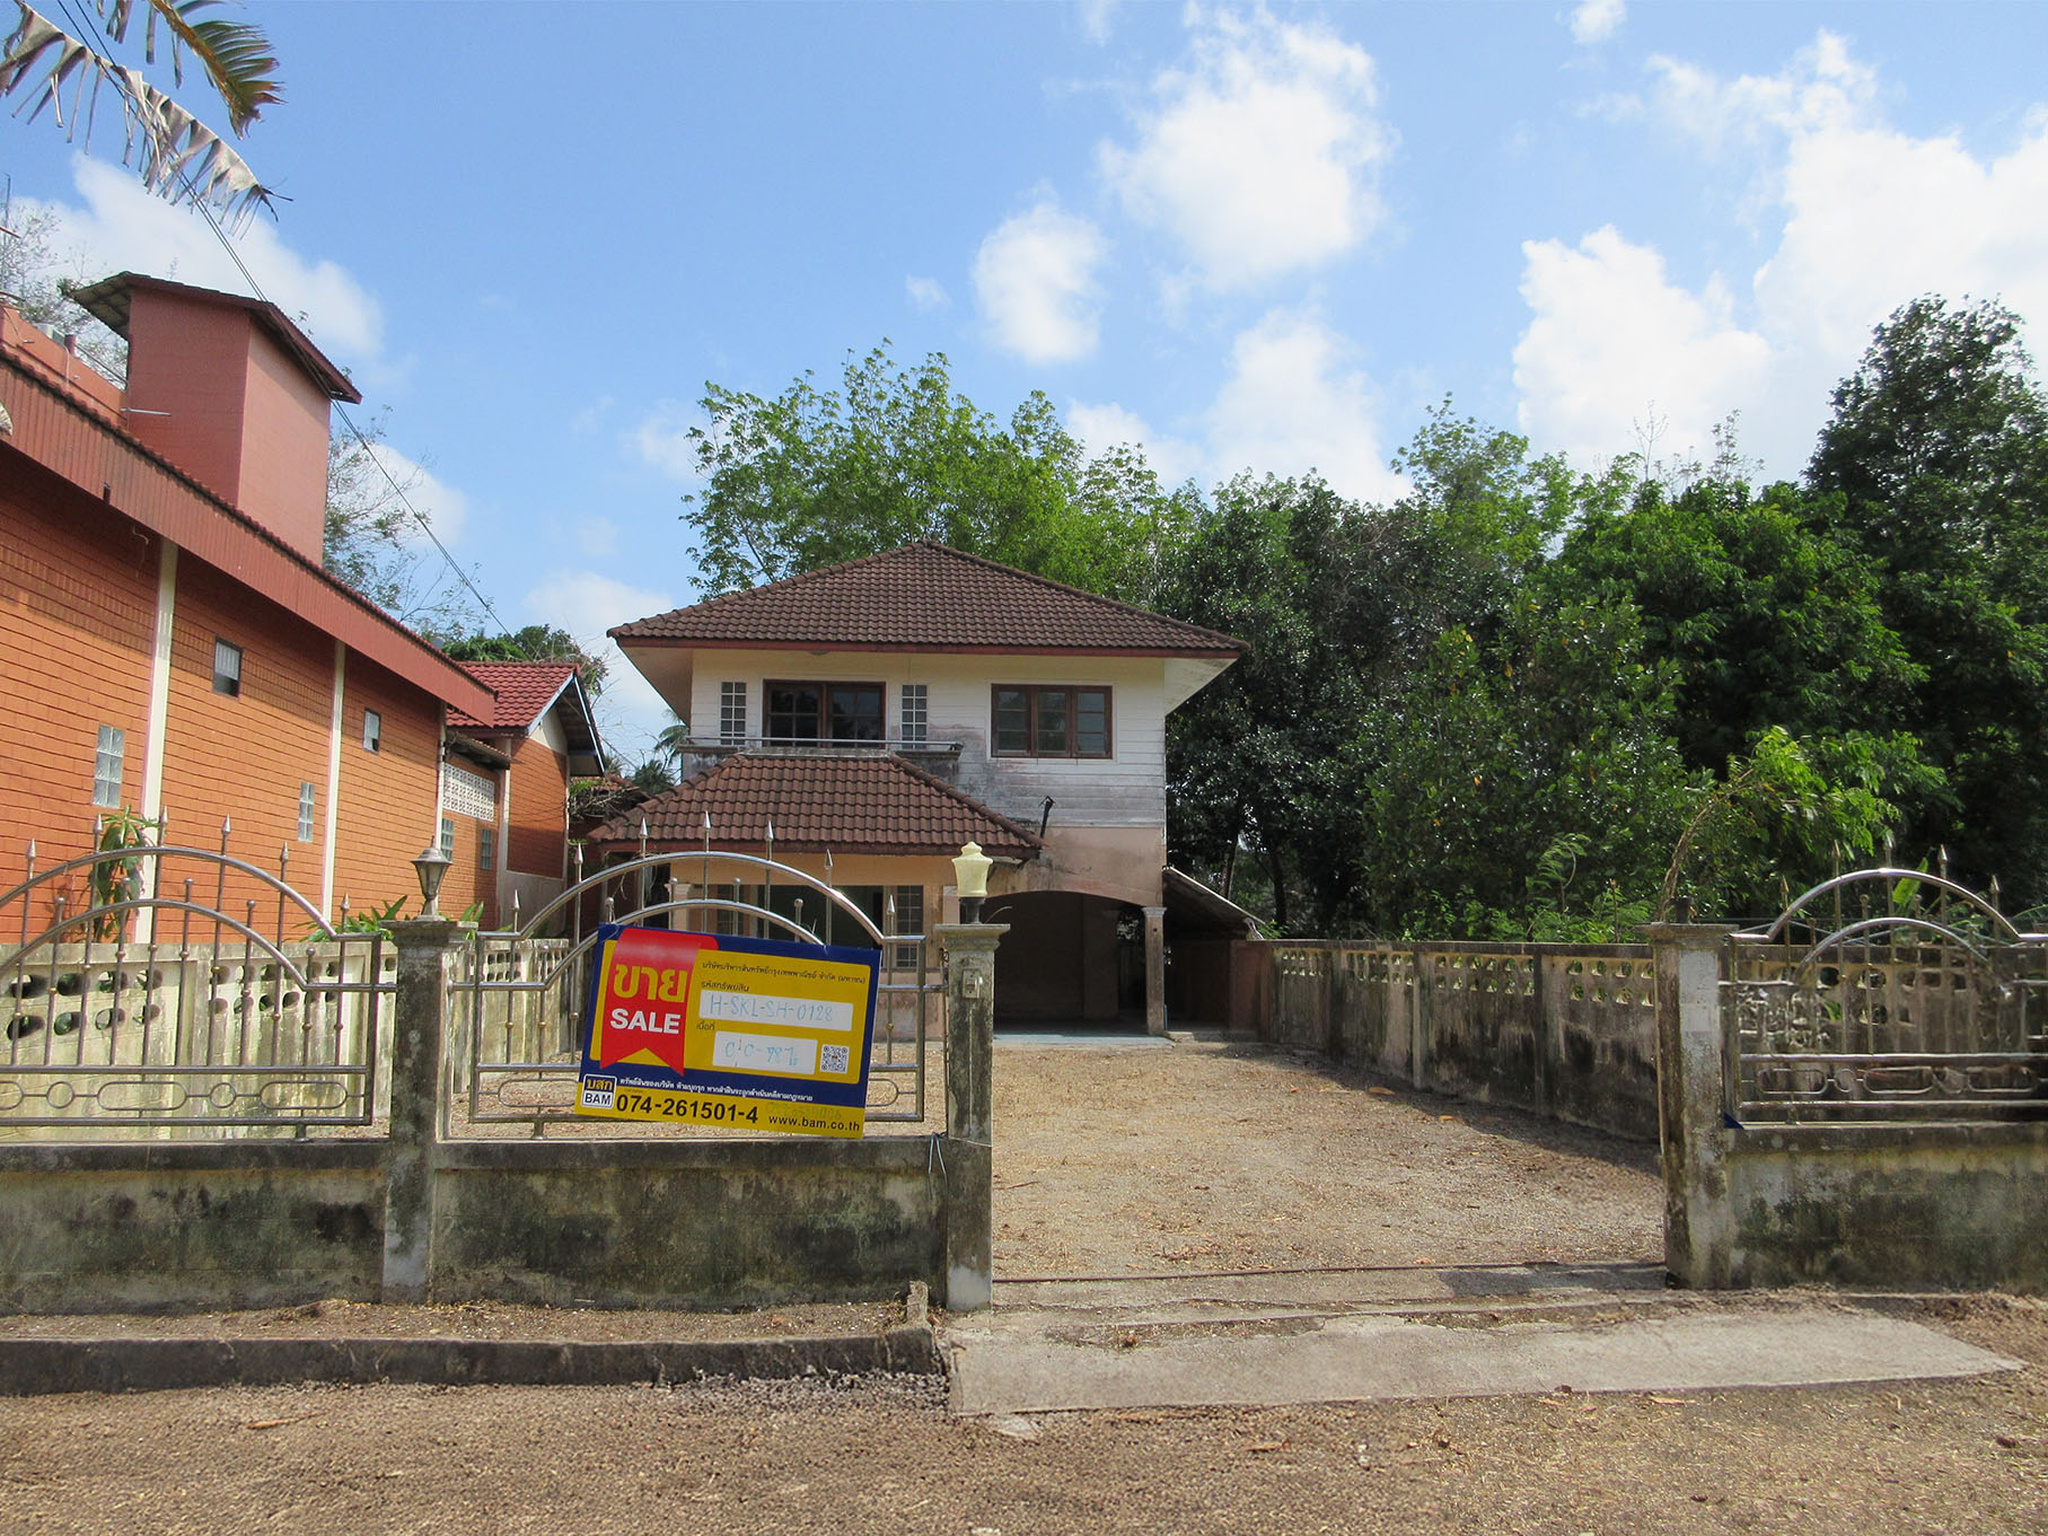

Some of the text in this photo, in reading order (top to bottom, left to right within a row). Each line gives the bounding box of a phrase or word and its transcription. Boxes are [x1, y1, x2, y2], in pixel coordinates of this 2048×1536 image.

[613, 964, 688, 1003] ขาย
[610, 1008, 681, 1034] SALE
[587, 1078, 613, 1091] บสก
[585, 1093, 611, 1106] BAM
[616, 1094, 759, 1124] 074-261501-4
[769, 1114, 861, 1132] www.bam.co.th
